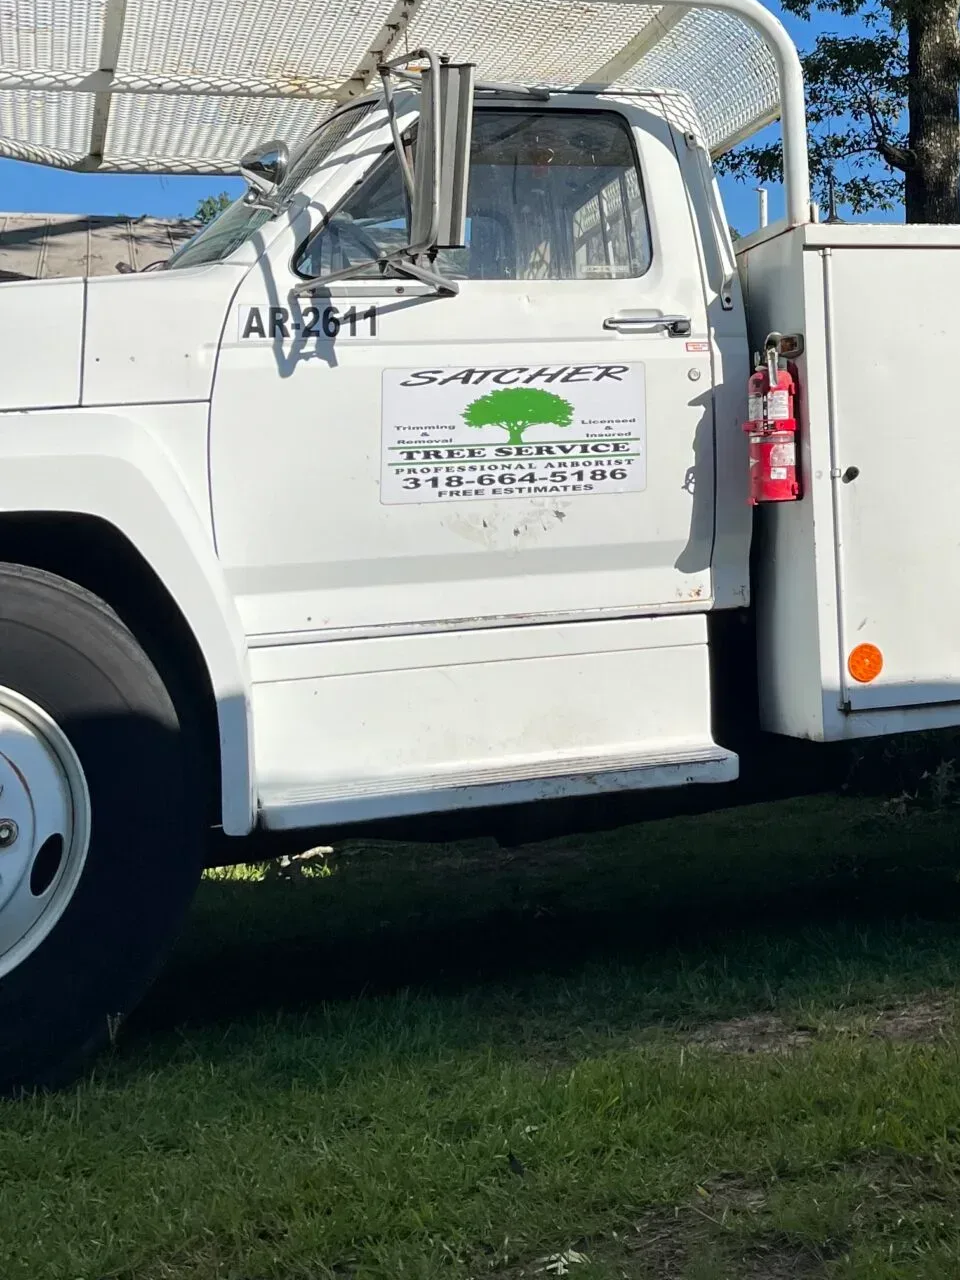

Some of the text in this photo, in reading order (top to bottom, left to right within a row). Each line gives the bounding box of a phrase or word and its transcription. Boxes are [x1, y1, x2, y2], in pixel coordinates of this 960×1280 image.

[242, 305, 377, 339] AR-2611
[399, 365, 630, 388] SATCHER
[580, 417, 636, 425] Licensed
[396, 437, 453, 445] Removal
[399, 442, 631, 461] TREE SERVICE
[394, 458, 635, 476] PROFESSIONAL ARBORIST
[401, 468, 628, 490] 318-664-5186
[437, 483, 594, 498] FREE ESTIMATES
